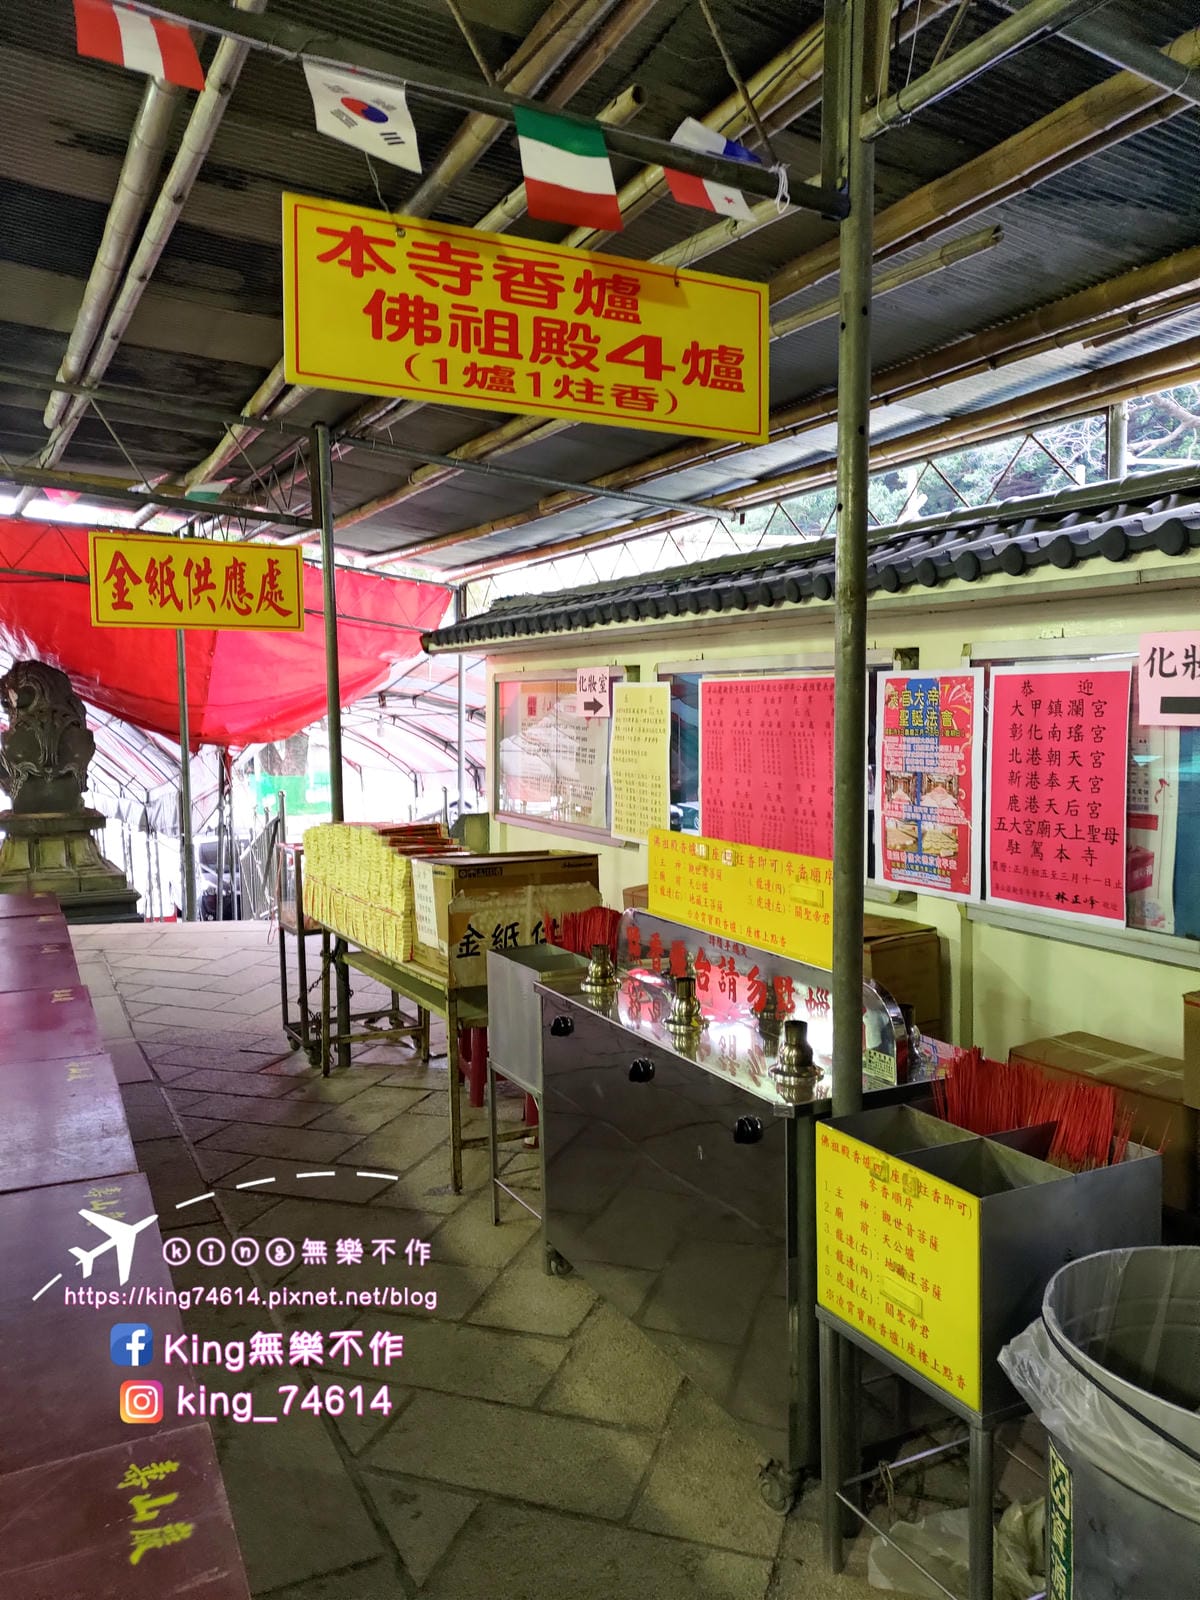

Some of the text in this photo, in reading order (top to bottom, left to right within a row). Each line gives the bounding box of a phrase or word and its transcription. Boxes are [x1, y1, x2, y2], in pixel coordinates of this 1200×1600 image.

[316, 225, 642, 326] 本寺香爐
[362, 288, 746, 394] 佛祖殿4爐
[405, 353, 678, 416] (1爐1炷香)
[103, 551, 293, 618] 金紙供應處
[579, 674, 608, 694] 化妝室
[1010, 698, 1108, 718] 大甲鎮瀾宮
[1009, 722, 1107, 743] 彰化南瑤宮
[1008, 746, 1105, 769] 北港朝天宮
[1008, 770, 1104, 794] 新港奉天宮
[1008, 794, 1102, 820] 鹿港天后宮
[994, 816, 1120, 846] 五大宮廟天上聖母
[1006, 839, 1098, 868] 駐駕本寺
